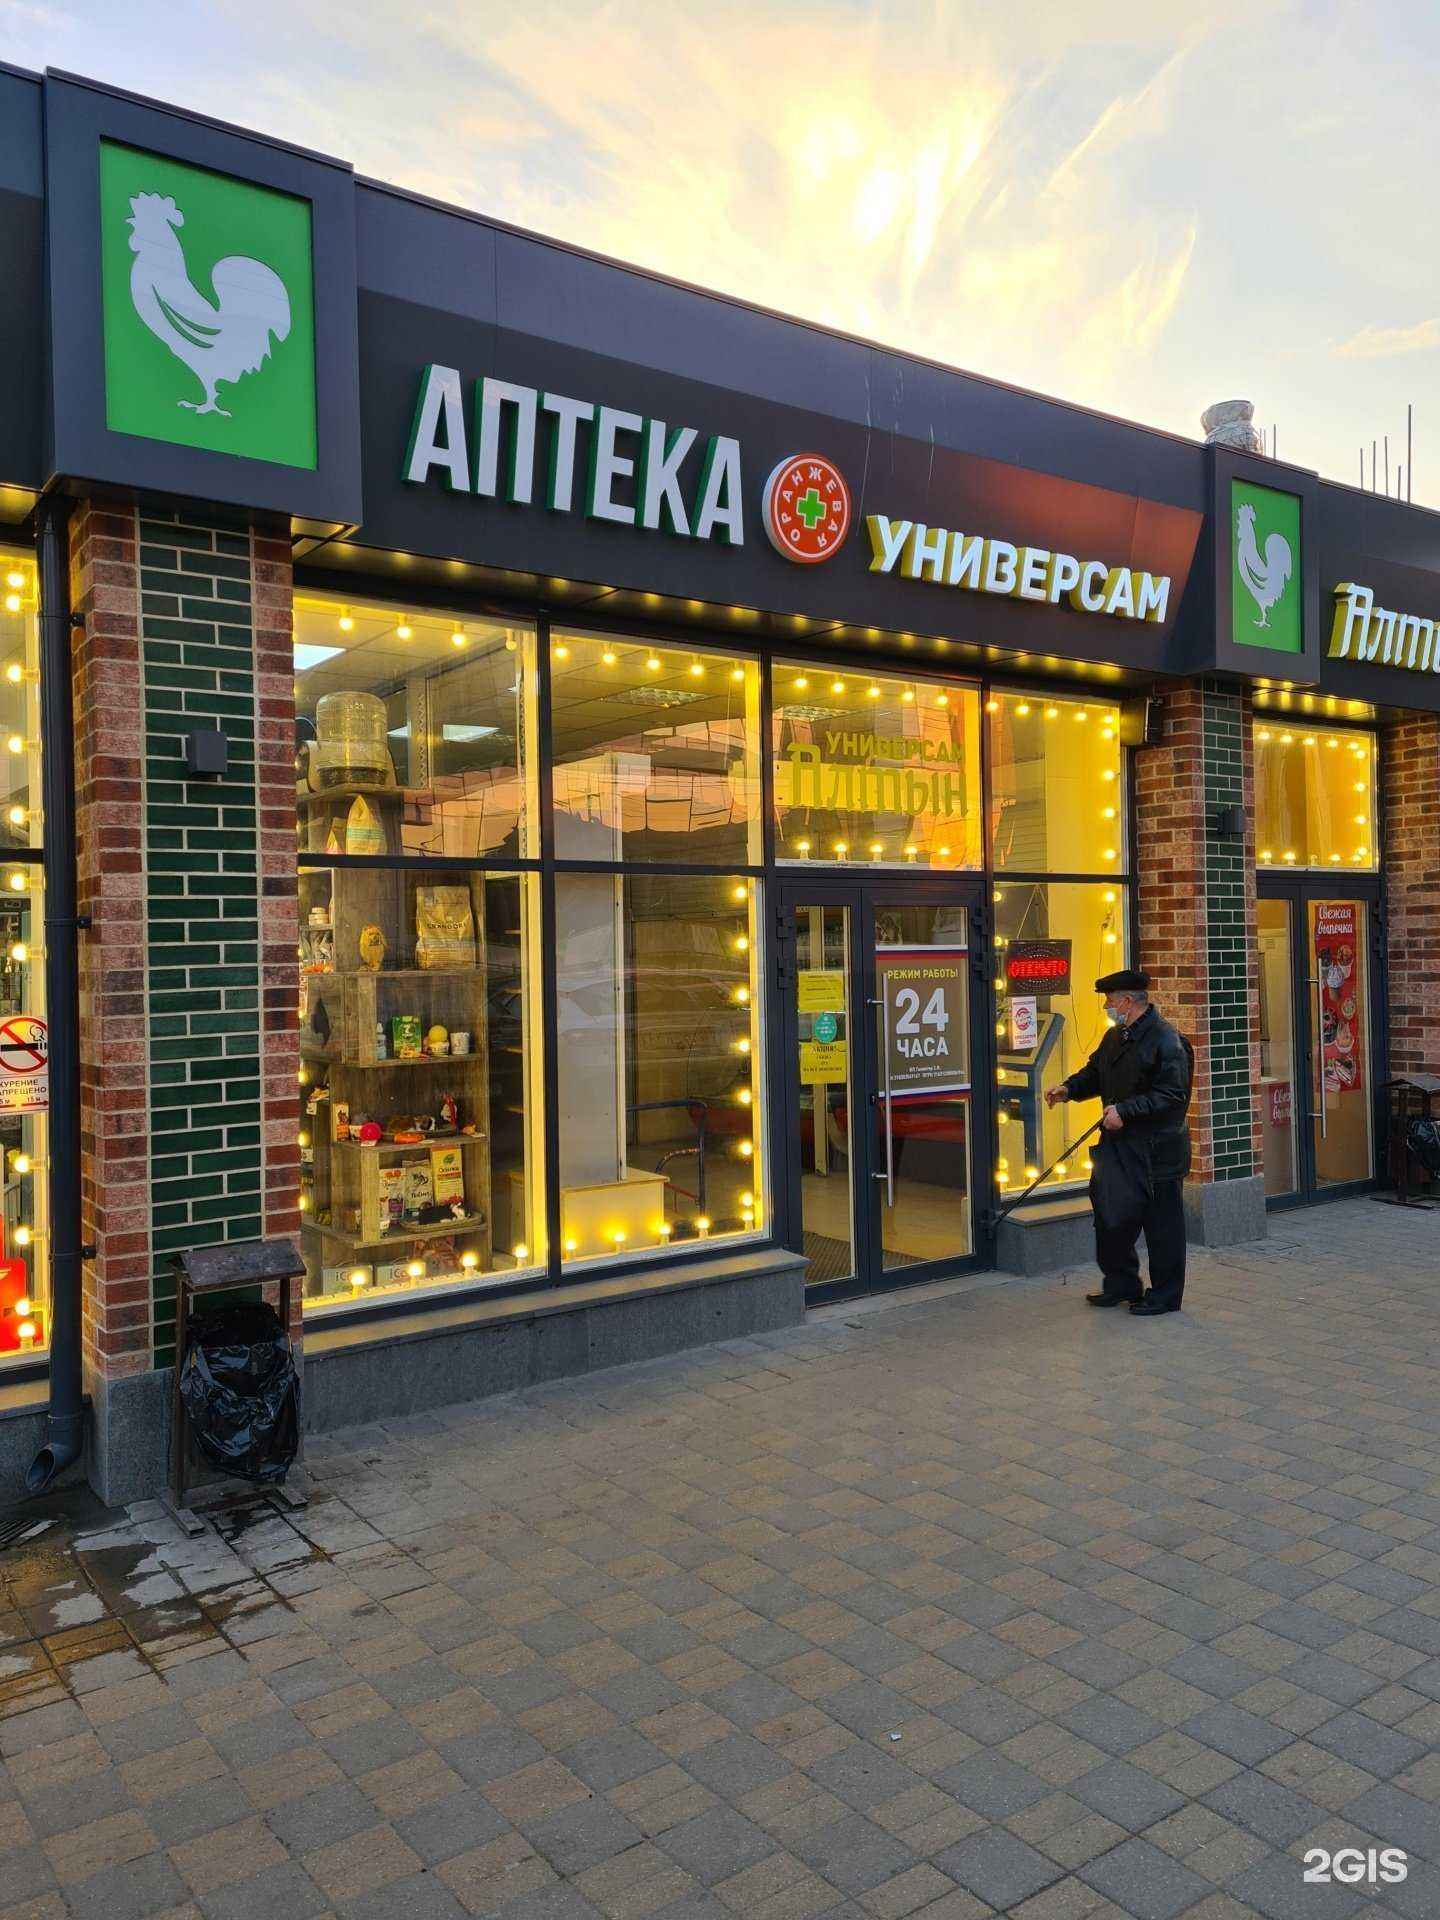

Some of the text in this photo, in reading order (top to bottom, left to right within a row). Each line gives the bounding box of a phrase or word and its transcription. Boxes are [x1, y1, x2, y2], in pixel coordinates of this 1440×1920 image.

[401, 363, 745, 545] АПТЕКА
[781, 466, 842, 547] ОРАНЖЕВАЯ
[866, 514, 1171, 623] УНИВЕРСАМ
[1327, 582, 1440, 674] Алт
[826, 730, 965, 763] УНИВЕРСАМ
[887, 968, 958, 980] РЕЖИМ РАБОТЫ
[895, 987, 949, 1034] 24
[896, 1036, 949, 1058] ЧАСА
